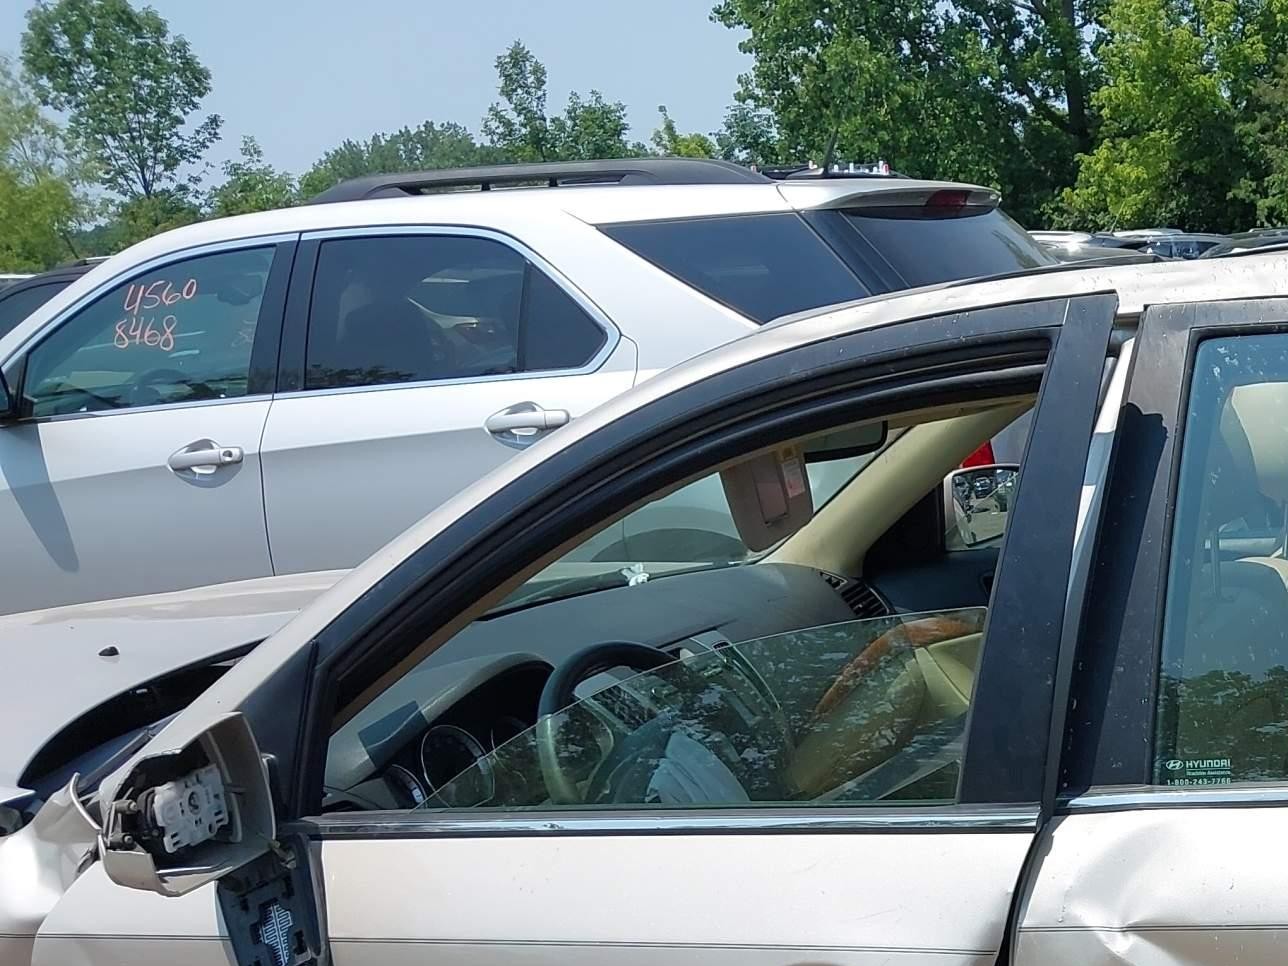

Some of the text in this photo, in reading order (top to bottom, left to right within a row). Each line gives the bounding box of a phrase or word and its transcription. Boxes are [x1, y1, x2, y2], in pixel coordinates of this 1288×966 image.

[123, 279, 197, 315] 4560
[114, 315, 178, 351] 8468
[1185, 759, 1231, 769] HYUNDAI
